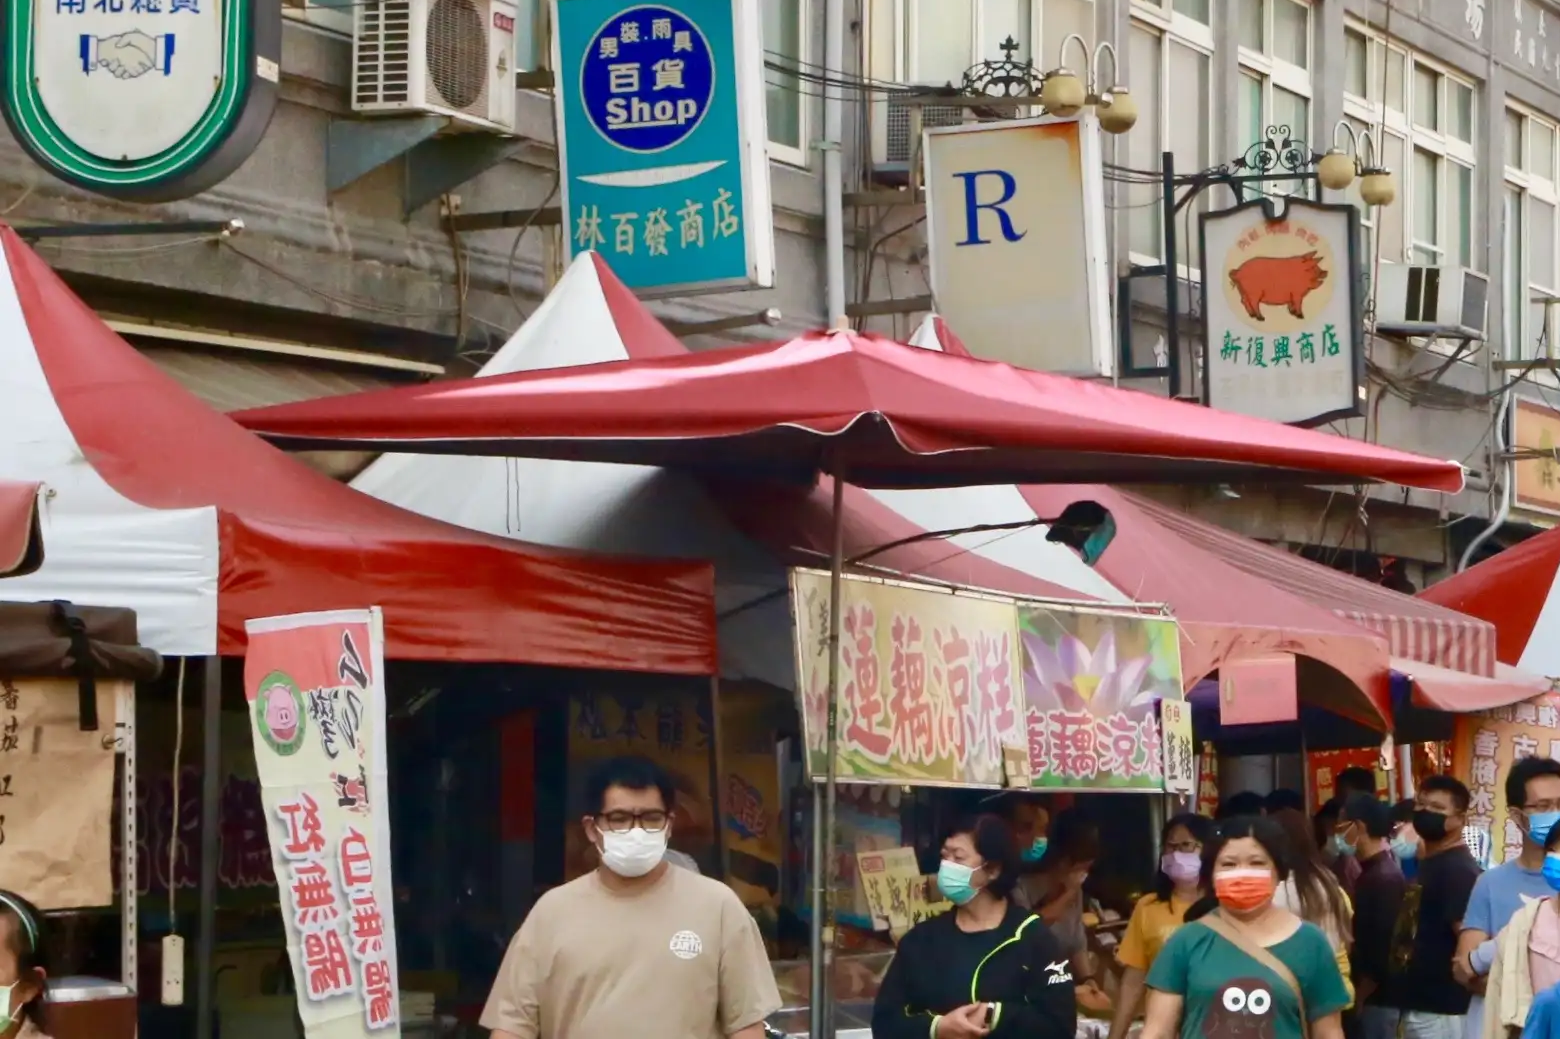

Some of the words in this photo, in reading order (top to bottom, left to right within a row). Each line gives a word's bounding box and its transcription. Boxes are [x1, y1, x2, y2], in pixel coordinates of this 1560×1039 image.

[607, 60, 687, 93] 百貨
[606, 96, 698, 125] Shop
[574, 188, 741, 257] 林百發商店
[952, 169, 1027, 247] R
[1220, 324, 1341, 368] 新復興商店
[843, 600, 1018, 768] 蓮藕涼糕
